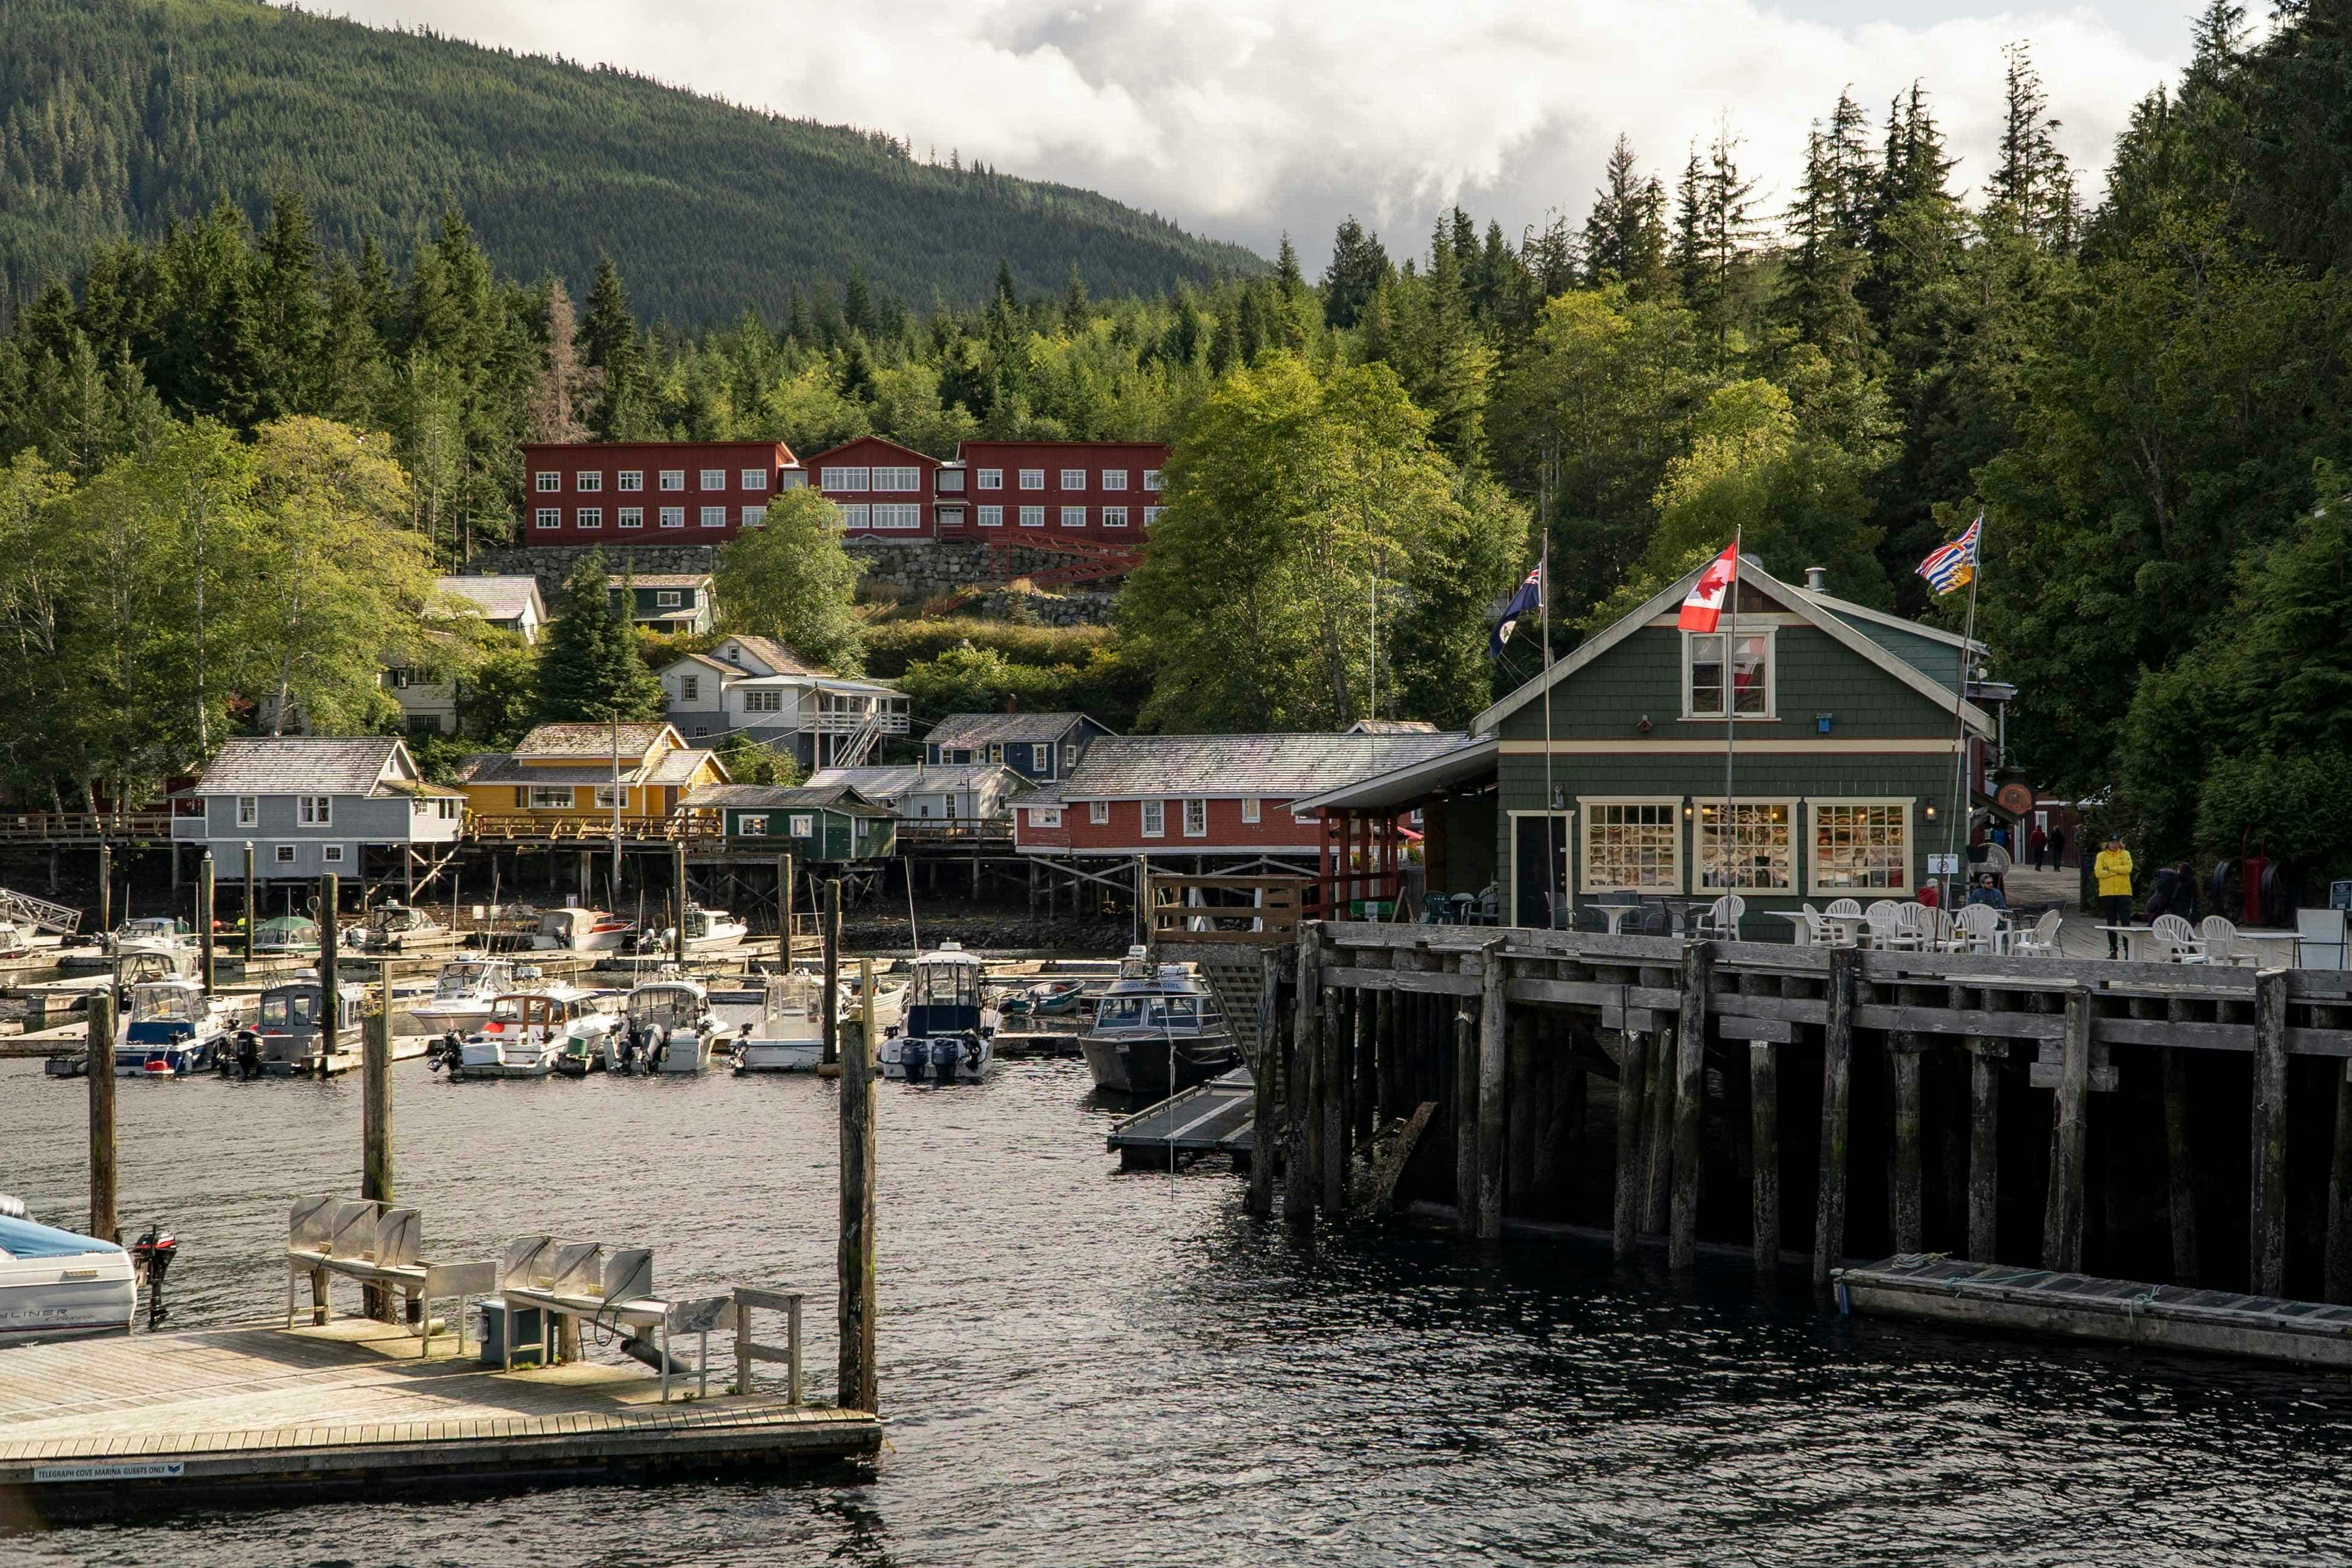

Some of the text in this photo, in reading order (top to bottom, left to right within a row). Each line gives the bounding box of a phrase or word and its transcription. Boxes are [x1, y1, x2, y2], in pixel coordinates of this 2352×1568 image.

[39, 1466, 165, 1478] TELEGRAPH COVE MARINA GUESTS ONLY
